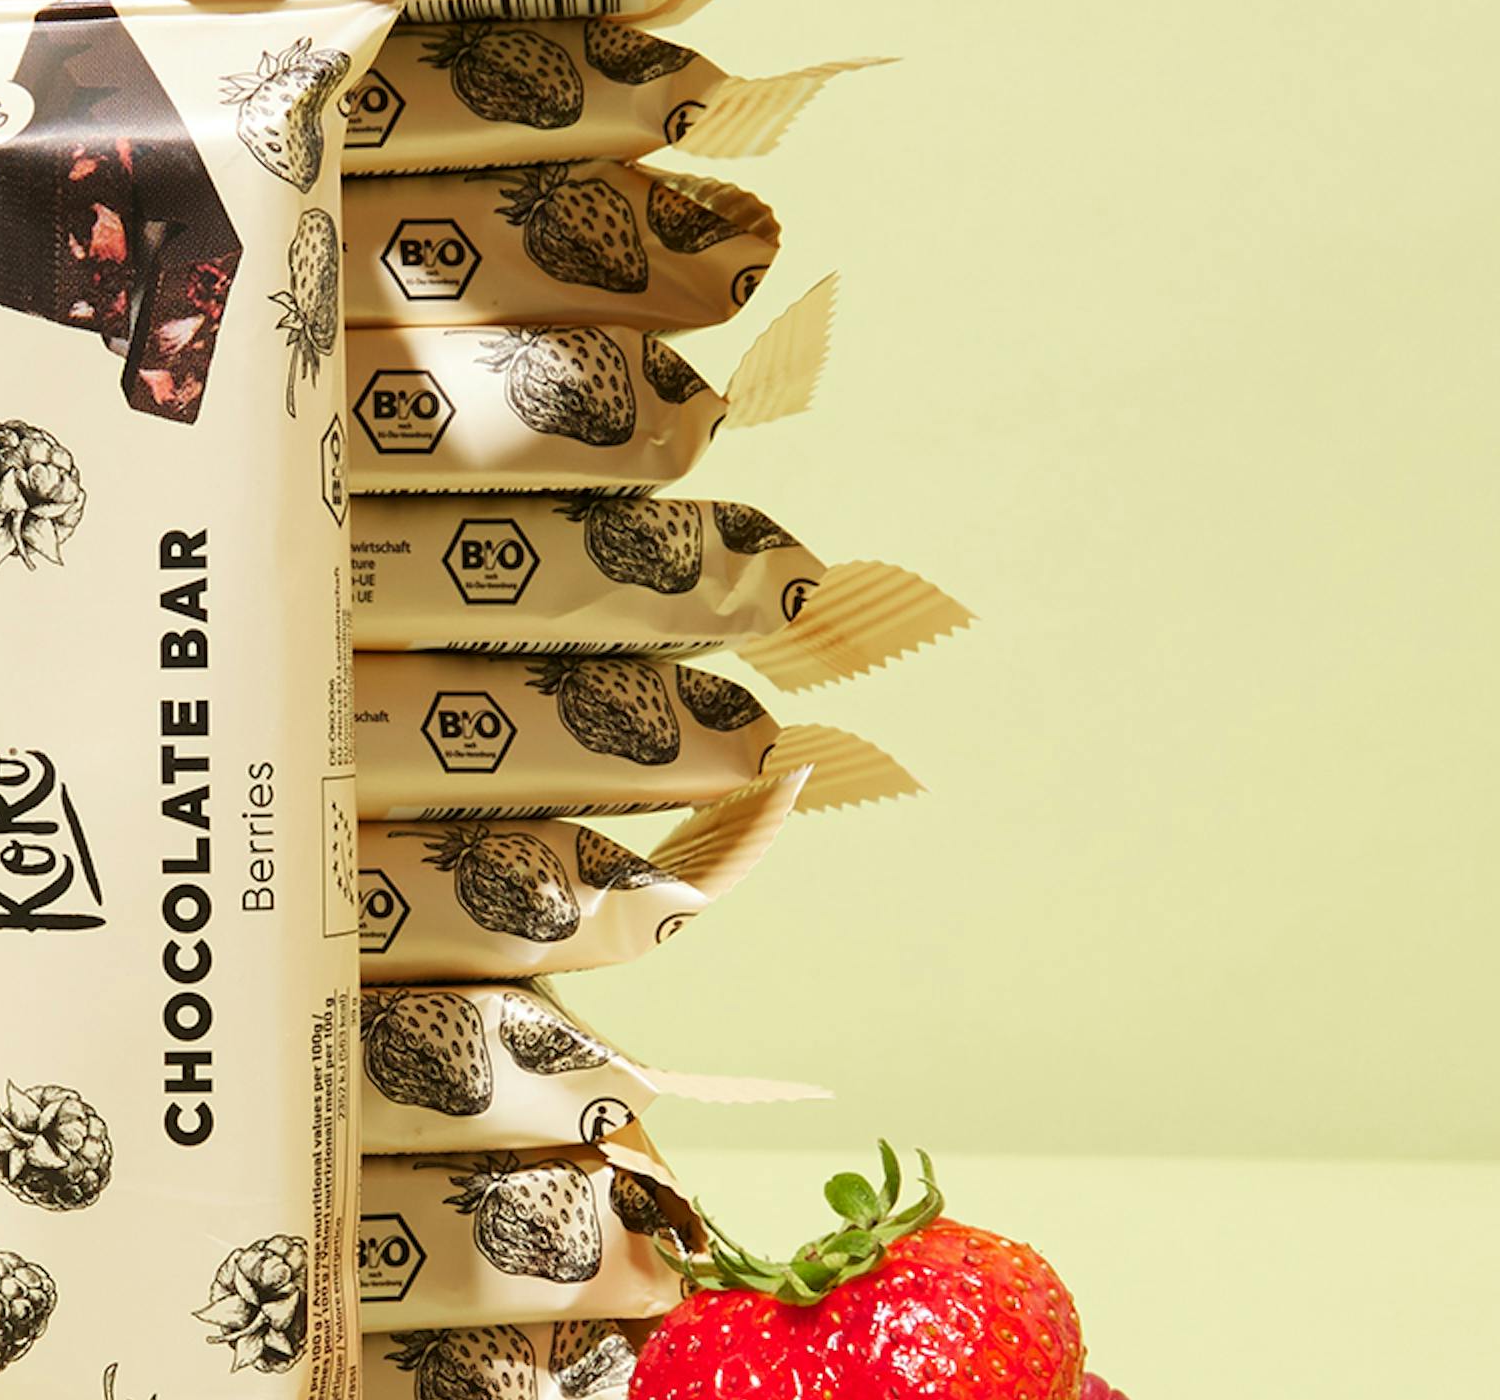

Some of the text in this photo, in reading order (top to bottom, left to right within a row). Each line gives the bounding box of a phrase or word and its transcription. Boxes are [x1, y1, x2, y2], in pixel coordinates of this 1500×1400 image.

[160, 528, 214, 1146] CHOCOLATE BAR
[242, 760, 274, 911] Berries
[311, 1024, 325, 1062] 100g
[312, 1066, 324, 1091] per
[311, 1096, 323, 1147] values
[312, 1152, 323, 1238] nutritional
